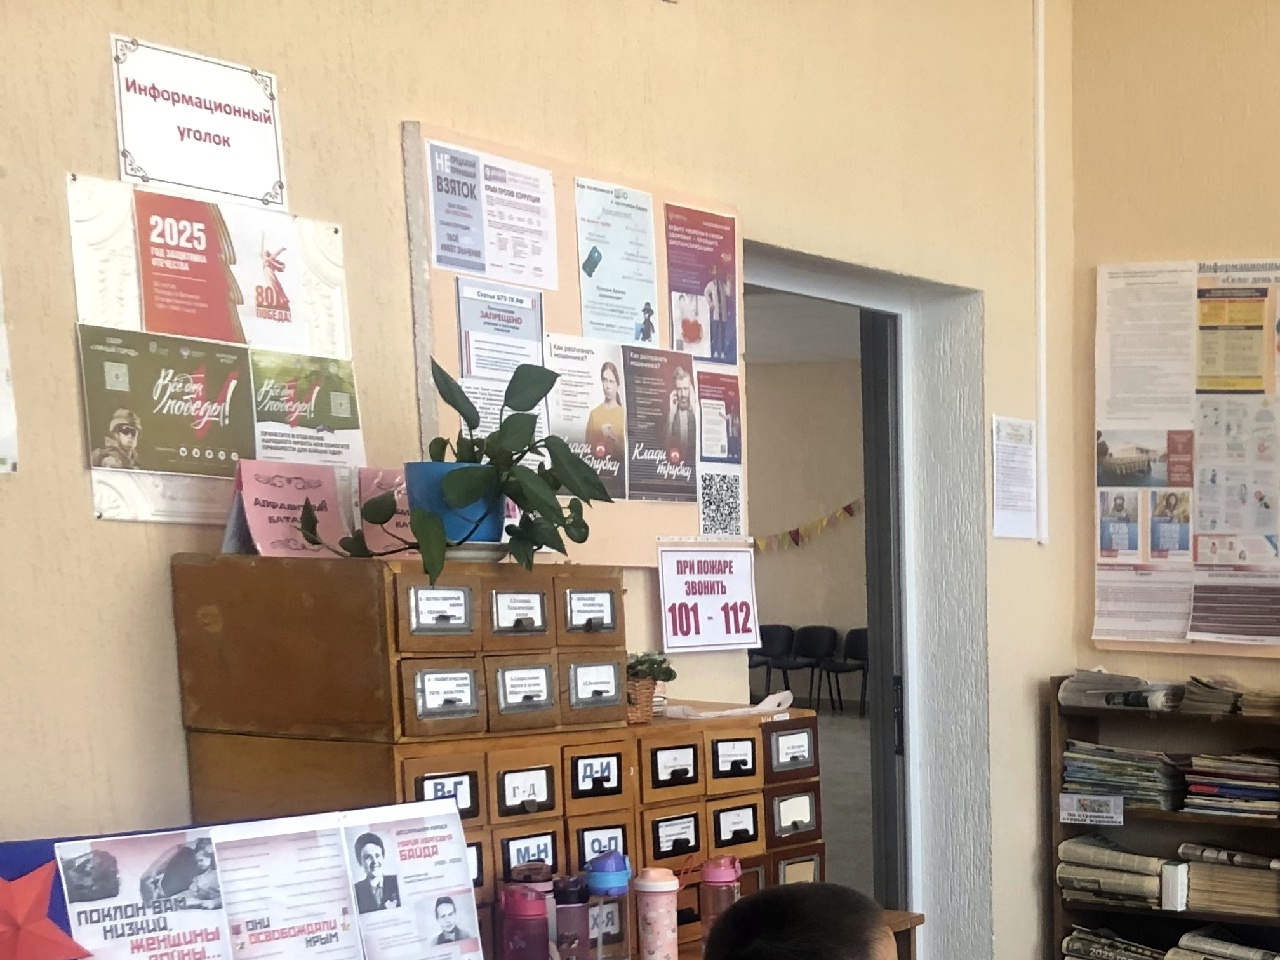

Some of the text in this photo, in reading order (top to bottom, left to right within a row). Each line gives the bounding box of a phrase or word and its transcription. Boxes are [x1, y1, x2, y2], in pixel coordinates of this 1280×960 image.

[125, 77, 272, 125] Информационный
[177, 125, 231, 148] уголок
[435, 151, 450, 174] НЕ
[437, 176, 477, 200] ВЗЯТОК
[150, 215, 206, 250] 2025
[256, 309, 291, 323] ПОБЕДА!
[480, 310, 522, 325] ЗАПРЕЩЕНО
[632, 443, 667, 464] Клади
[657, 460, 692, 481] трубку
[676, 560, 733, 575] ПРИ ПОЖАРЕ
[685, 580, 726, 596] ЗВОНИТЬ
[668, 602, 700, 636] 101
[721, 601, 752, 634] 112
[582, 760, 611, 782] Д-И
[433, 780, 464, 798] В-Г
[399, 844, 439, 861] БАЙДА
[516, 843, 549, 863] М-Н
[591, 836, 618, 854] О-П
[77, 897, 187, 926] ПОКЛОН ВАМ
[245, 917, 270, 931] ОНИ
[248, 919, 337, 944] ОСВОБОЖДАЛИ
[130, 926, 221, 954] ЖЕНЩИНЫ
[305, 932, 339, 948] КРЫМ
[1089, 947, 1115, 960] 2025
